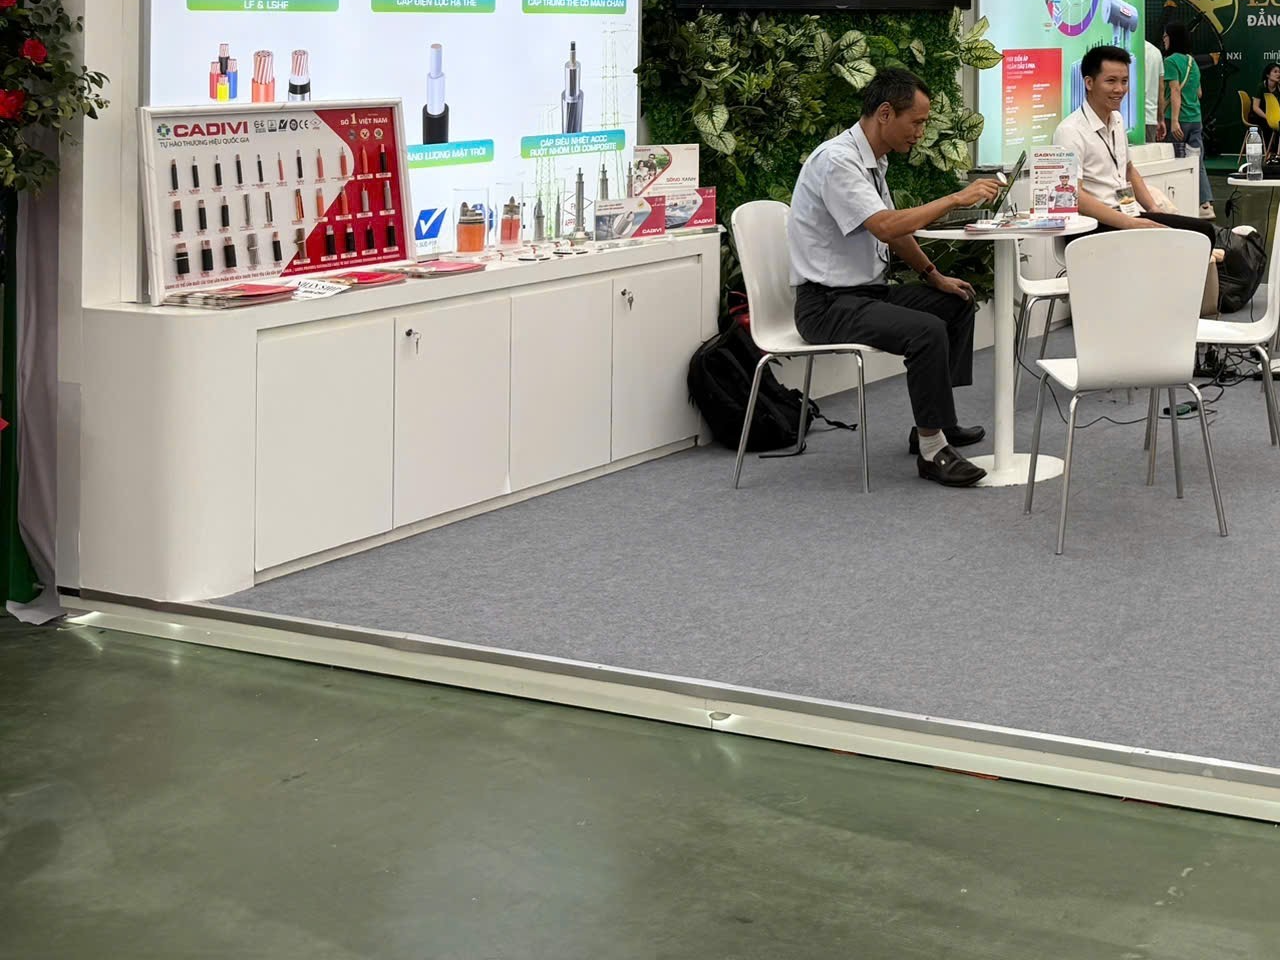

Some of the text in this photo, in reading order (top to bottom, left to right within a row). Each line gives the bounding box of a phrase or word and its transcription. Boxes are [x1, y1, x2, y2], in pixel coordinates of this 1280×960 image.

[350, 113, 357, 125] 1
[373, 117, 388, 125] NAM
[173, 121, 249, 137] CADIVI
